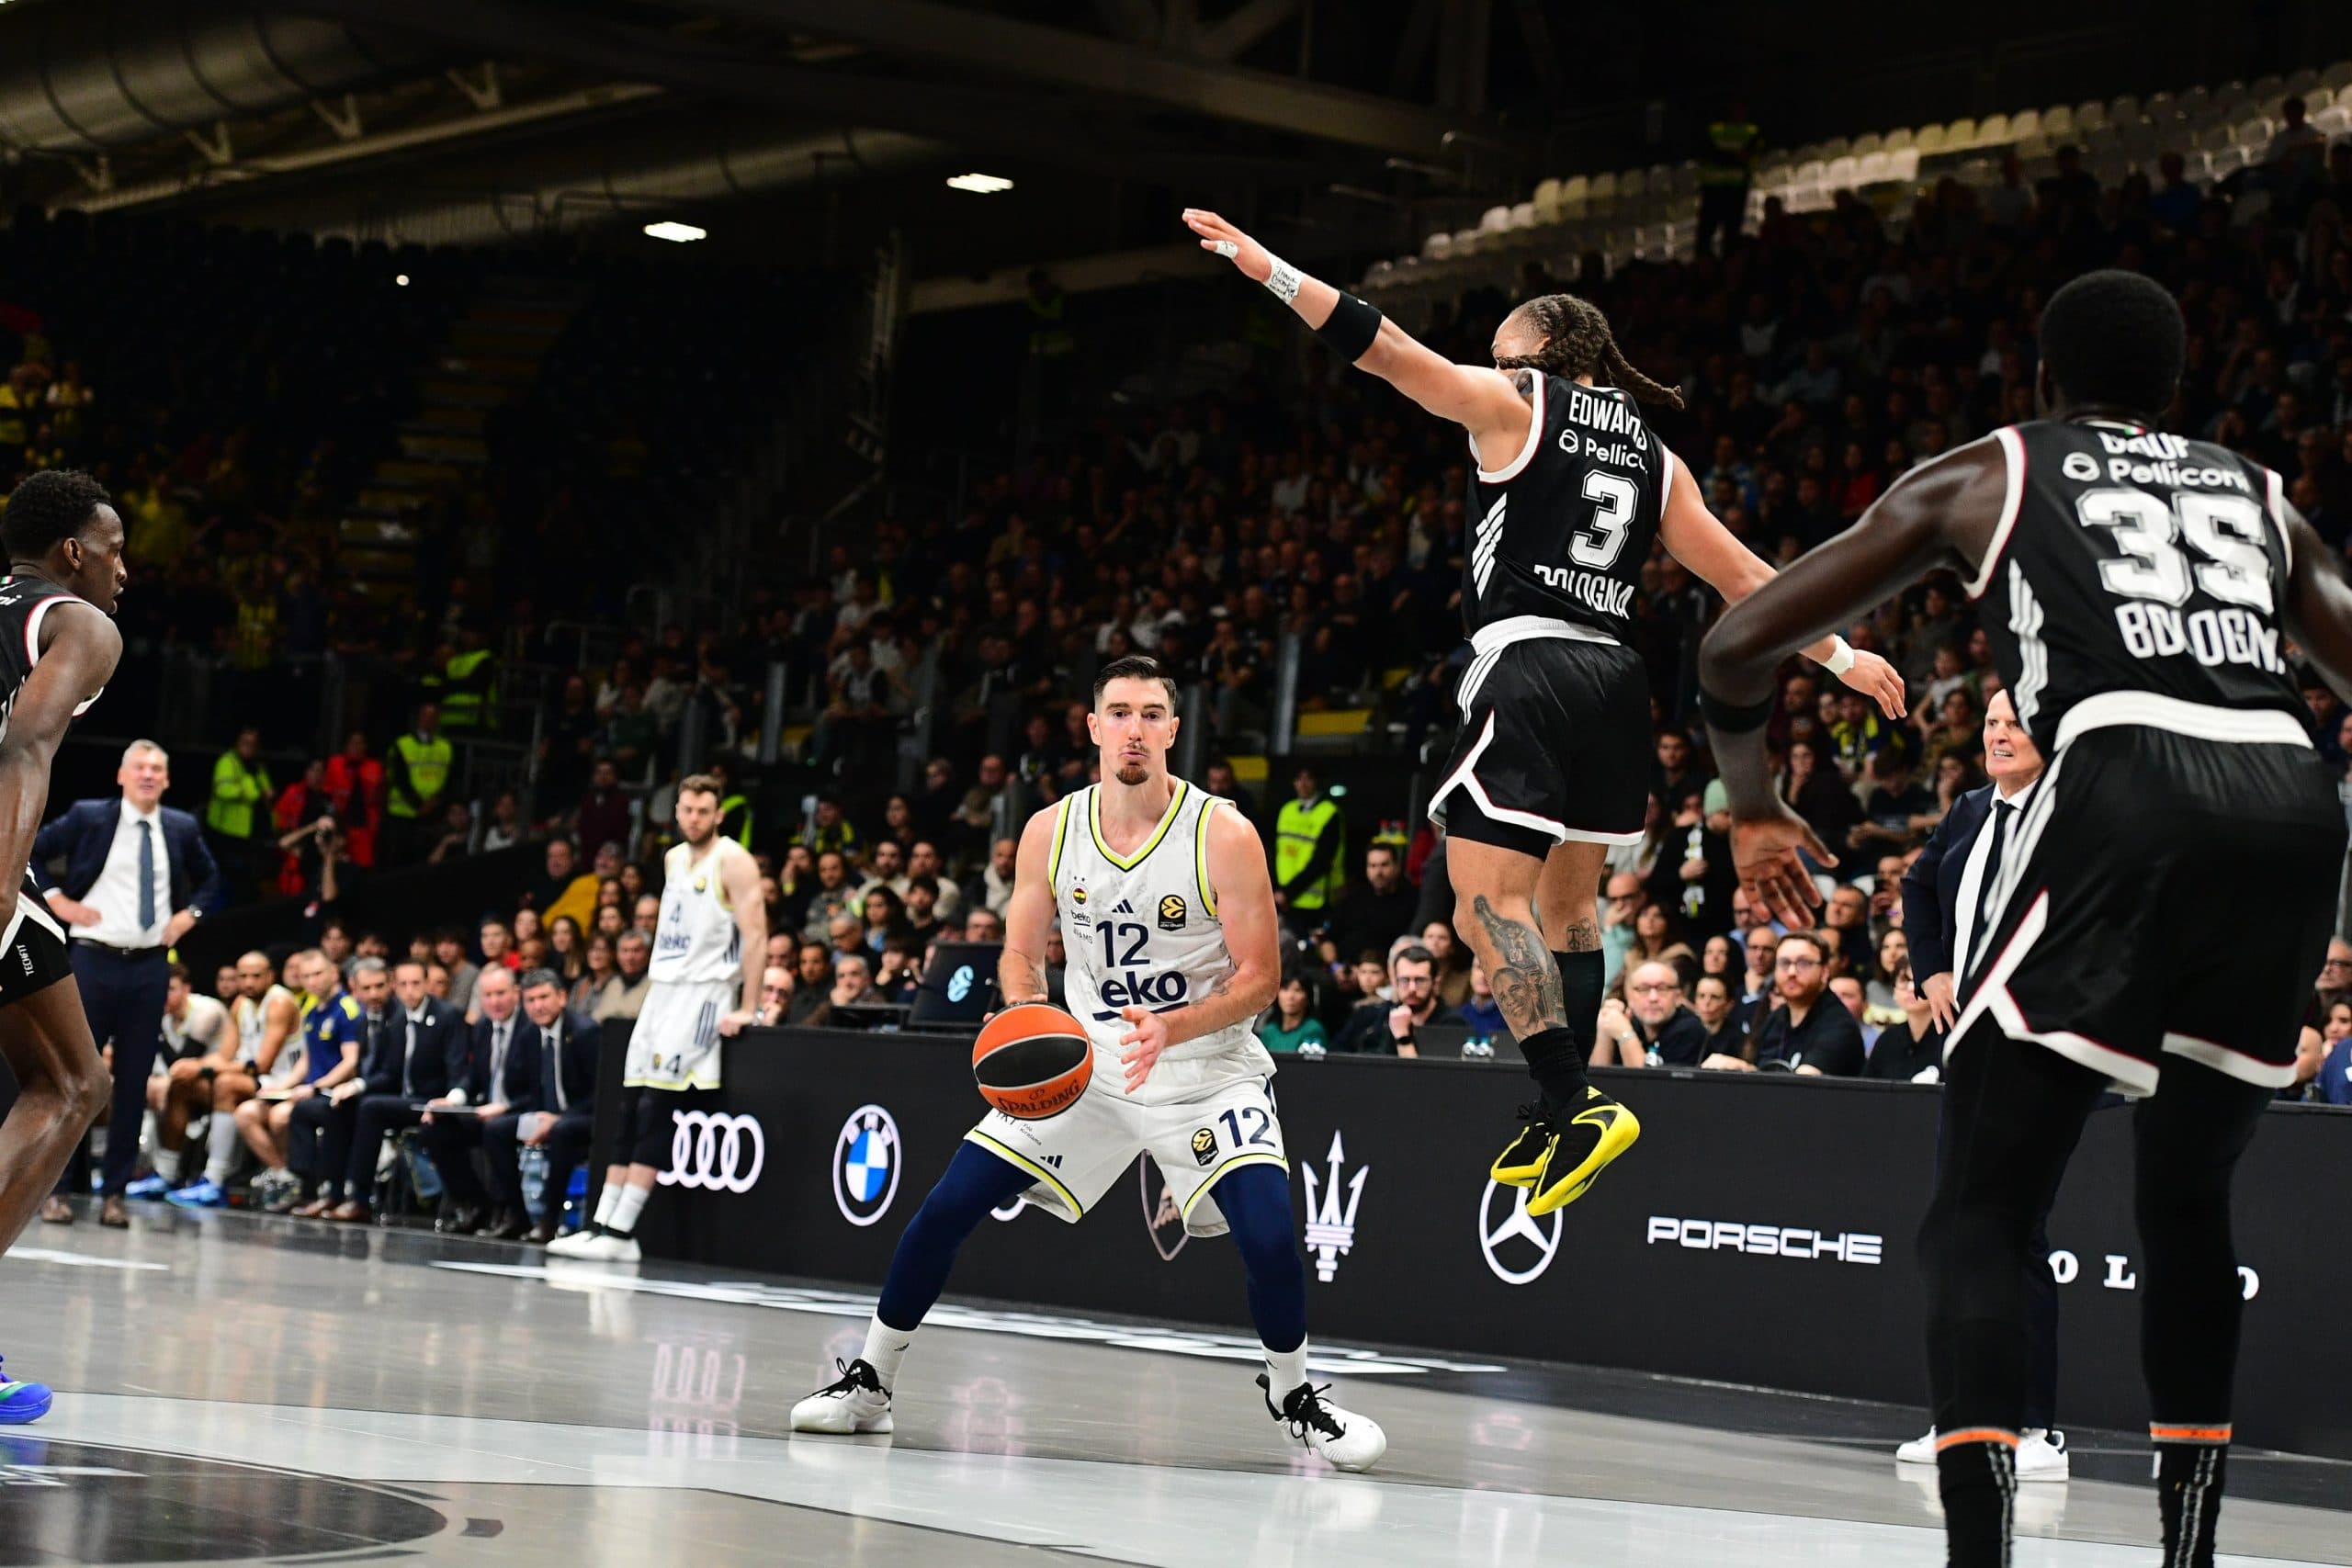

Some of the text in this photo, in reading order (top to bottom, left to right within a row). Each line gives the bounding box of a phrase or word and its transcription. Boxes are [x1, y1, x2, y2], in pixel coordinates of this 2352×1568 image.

[1568, 469, 1639, 570] 3
[2075, 488, 2275, 615] 35
[1096, 920, 1150, 968] 12
[665, 1054, 682, 1077] 4
[997, 1078, 1081, 1112] SPALDING
[1218, 1106, 1276, 1148] 12
[1647, 1215, 1883, 1265] PORSCHE
